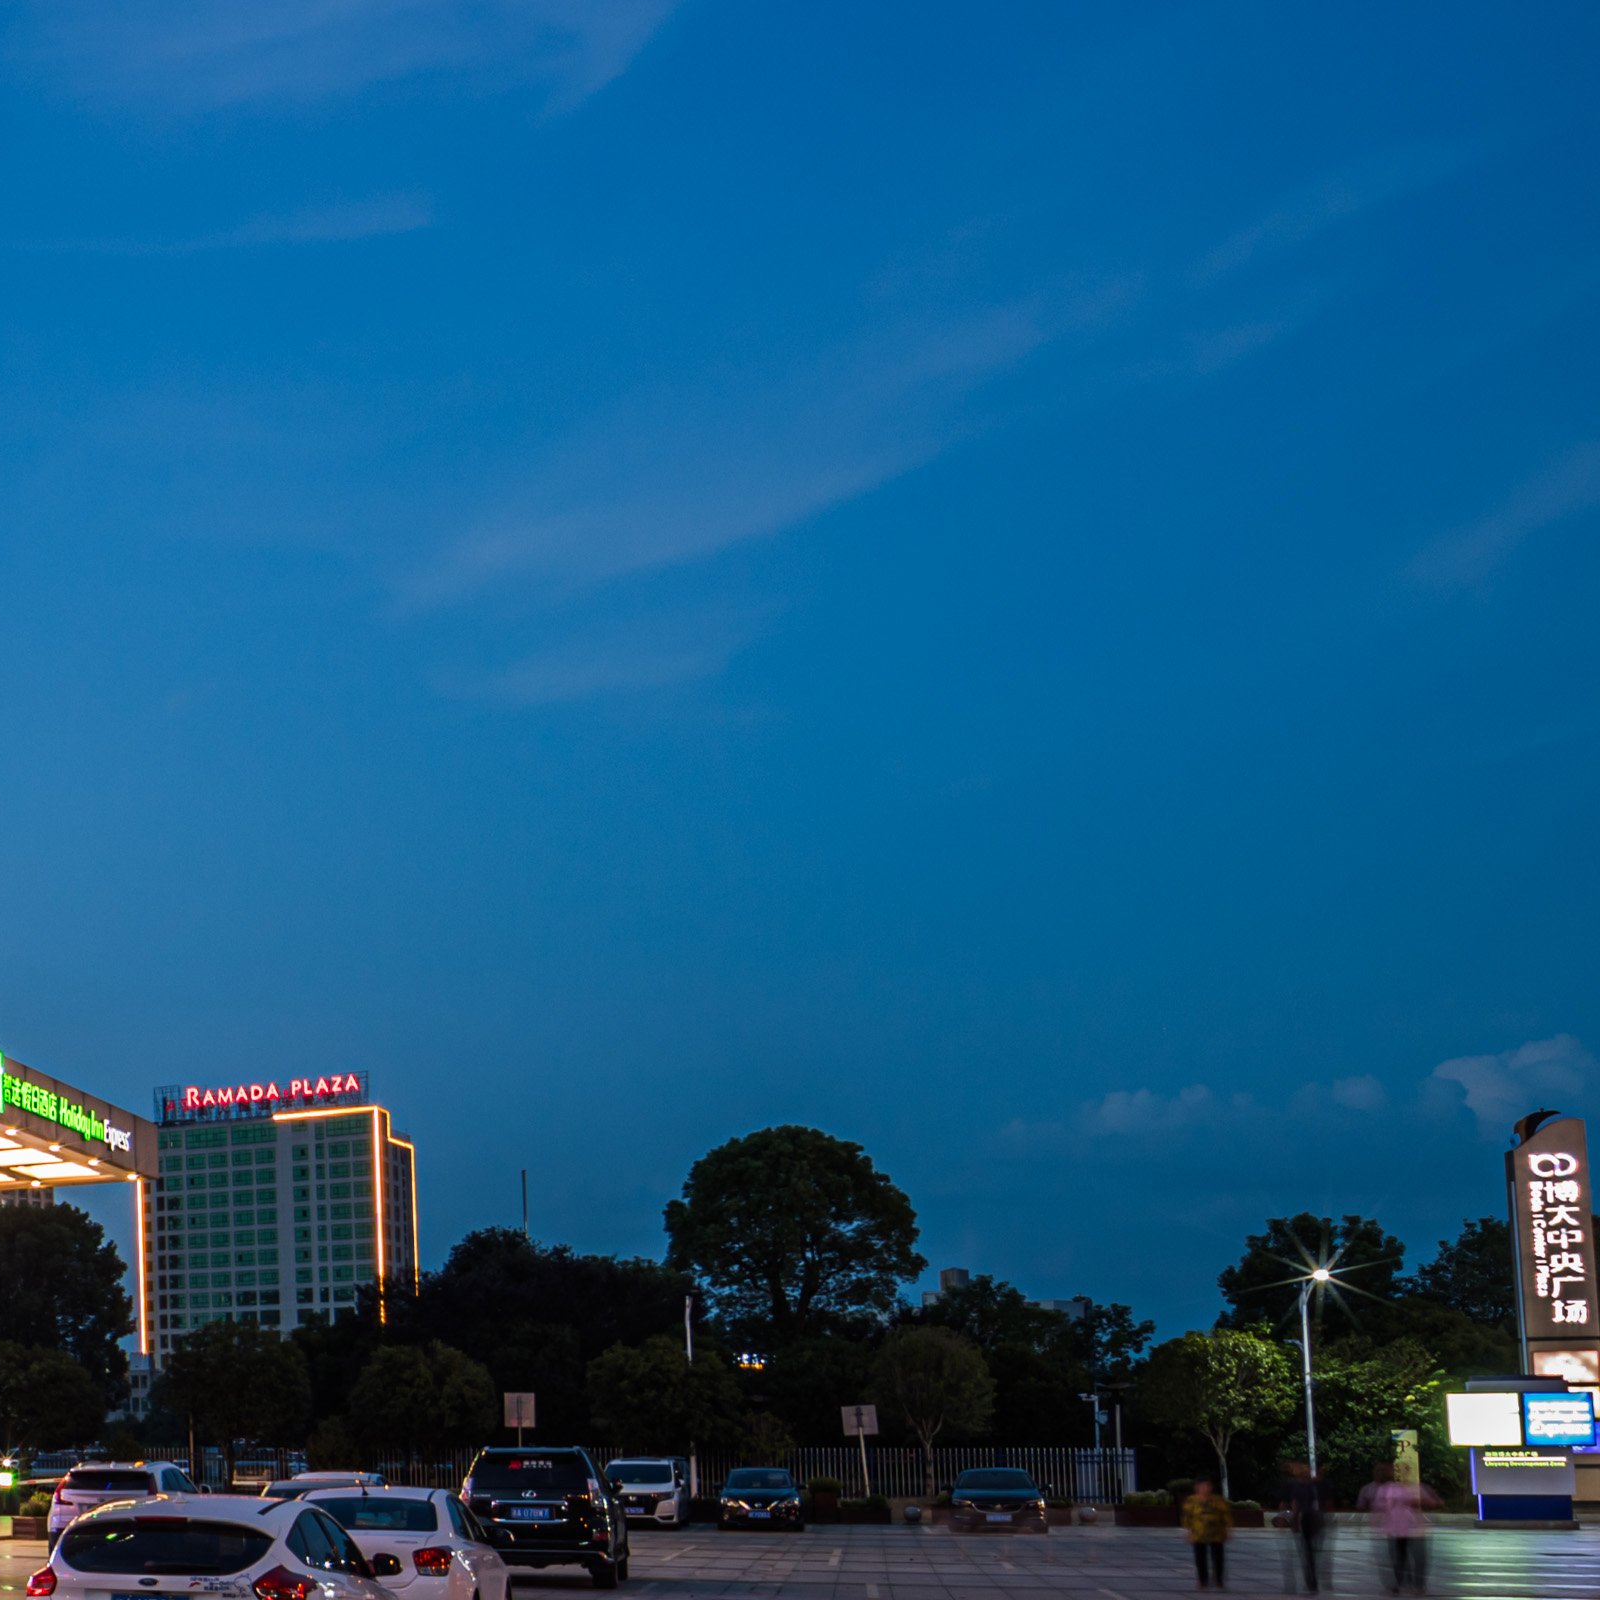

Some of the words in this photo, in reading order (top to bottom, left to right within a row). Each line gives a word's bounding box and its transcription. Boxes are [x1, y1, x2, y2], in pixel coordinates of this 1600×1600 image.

[186, 1081, 279, 1108] RAMADA
[291, 1072, 360, 1097] PLAZA
[1545, 1179, 1588, 1325] 博大中央广场
